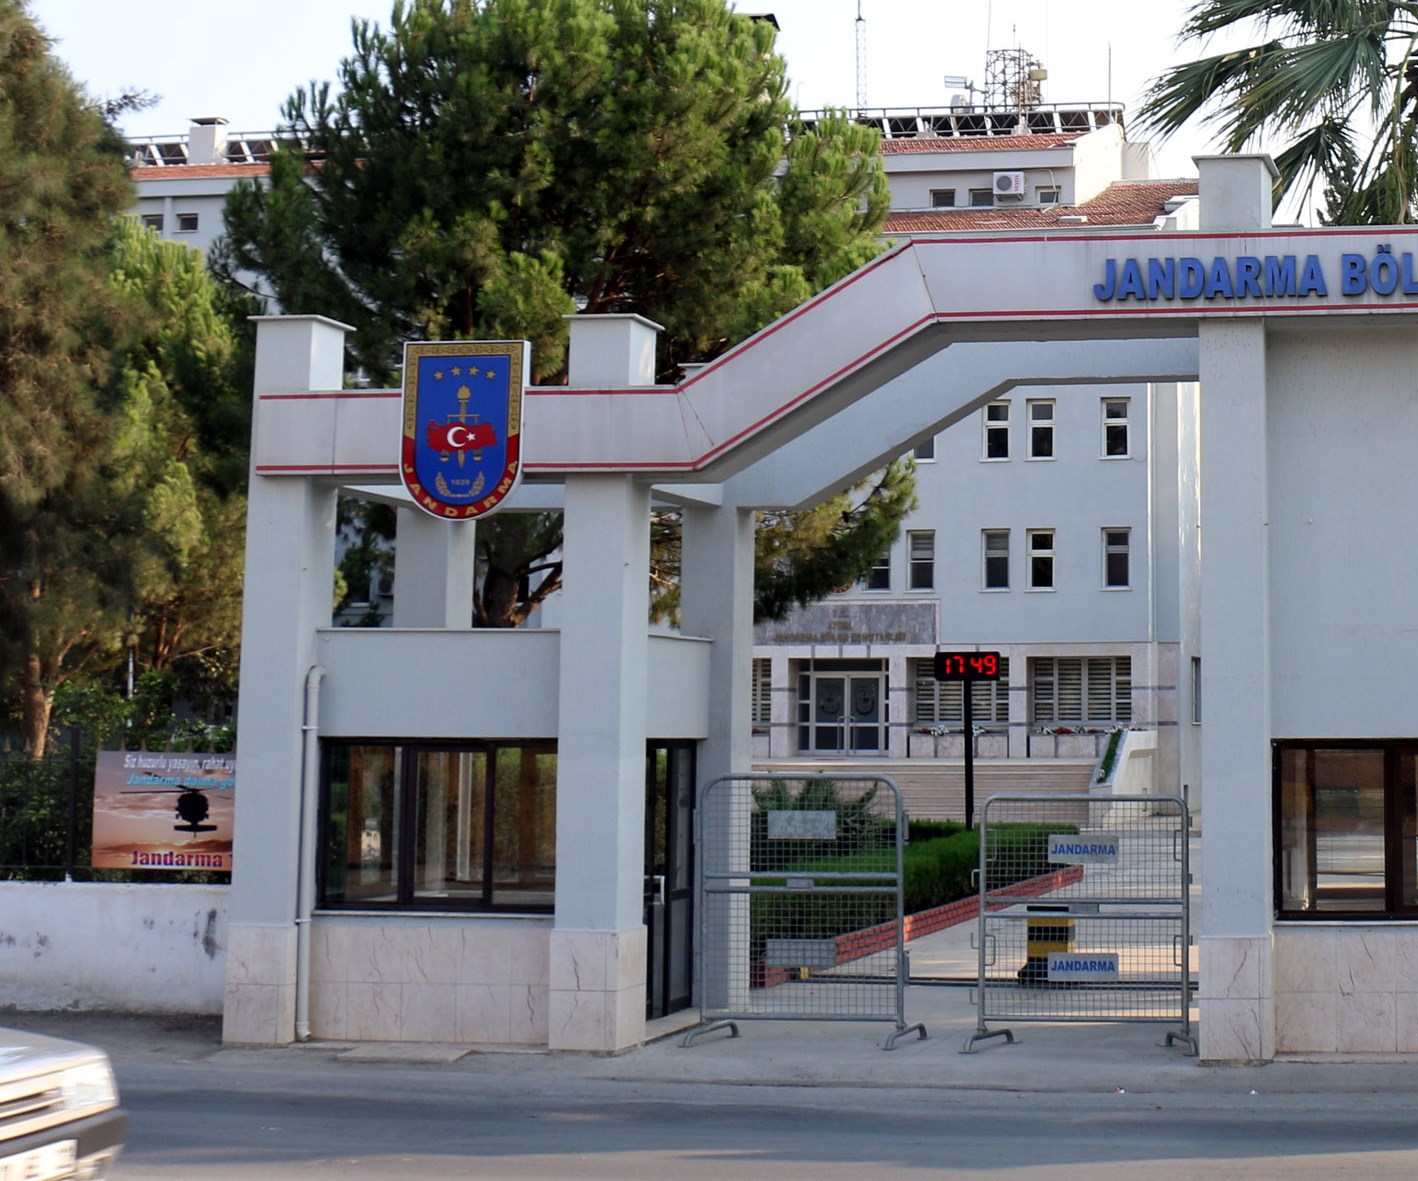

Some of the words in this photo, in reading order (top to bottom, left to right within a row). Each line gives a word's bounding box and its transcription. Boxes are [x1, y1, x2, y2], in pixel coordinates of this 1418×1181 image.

[1093, 254, 1328, 302] JANDARMA
[404, 461, 518, 517] JANDARMA
[124, 754, 136, 768] Siz
[127, 773, 181, 786] Jandarma
[1051, 844, 1116, 856] JANDARMA
[131, 850, 223, 867] Jandarma
[1051, 960, 1115, 972] JANDARMA
